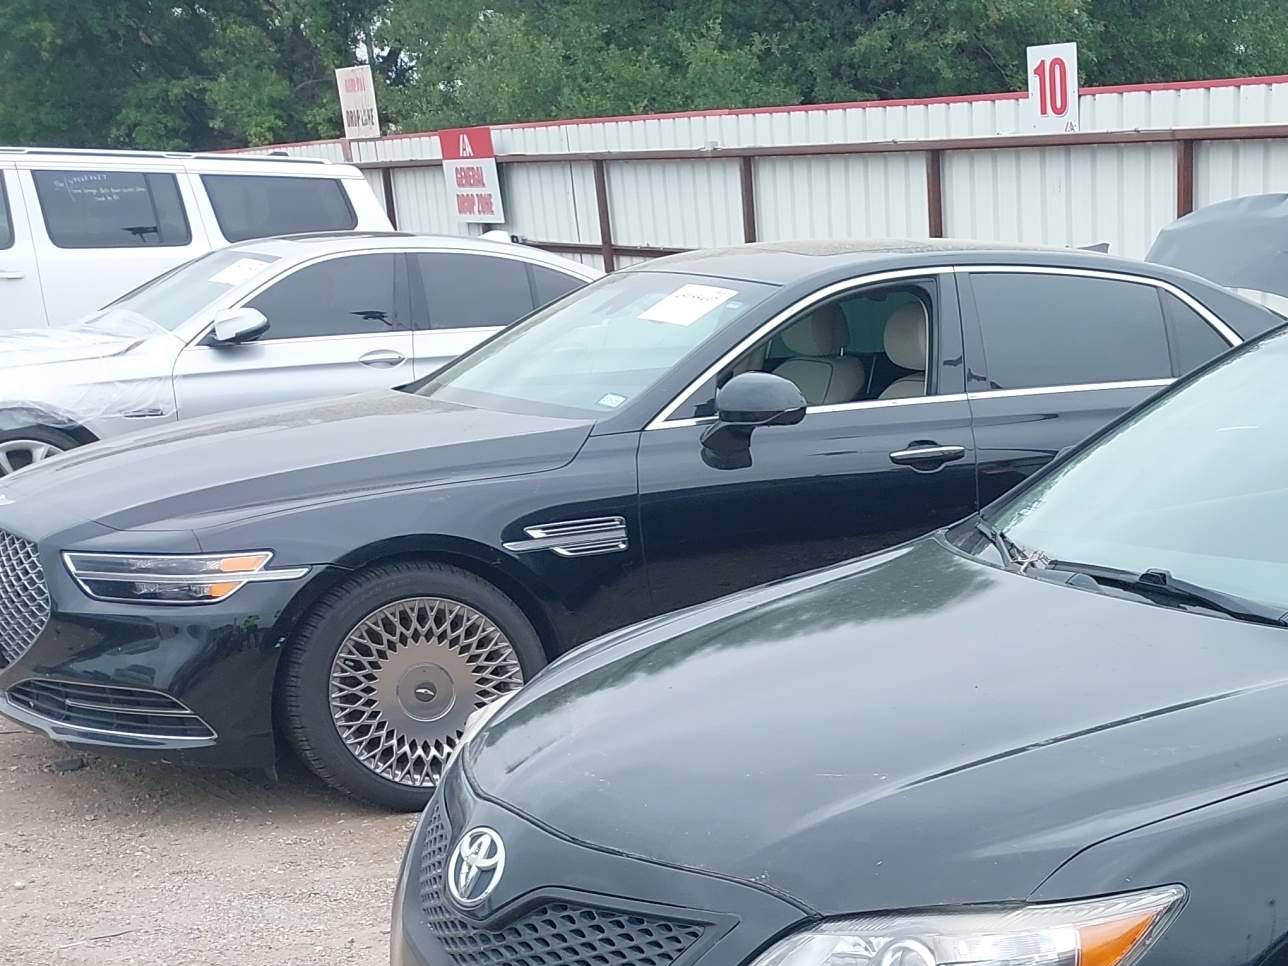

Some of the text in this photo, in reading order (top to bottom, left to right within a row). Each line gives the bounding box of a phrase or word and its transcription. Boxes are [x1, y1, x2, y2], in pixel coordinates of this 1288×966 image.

[1033, 57, 1068, 115] 10
[455, 166, 486, 188] GENERAL
[456, 193, 475, 215] DROP
